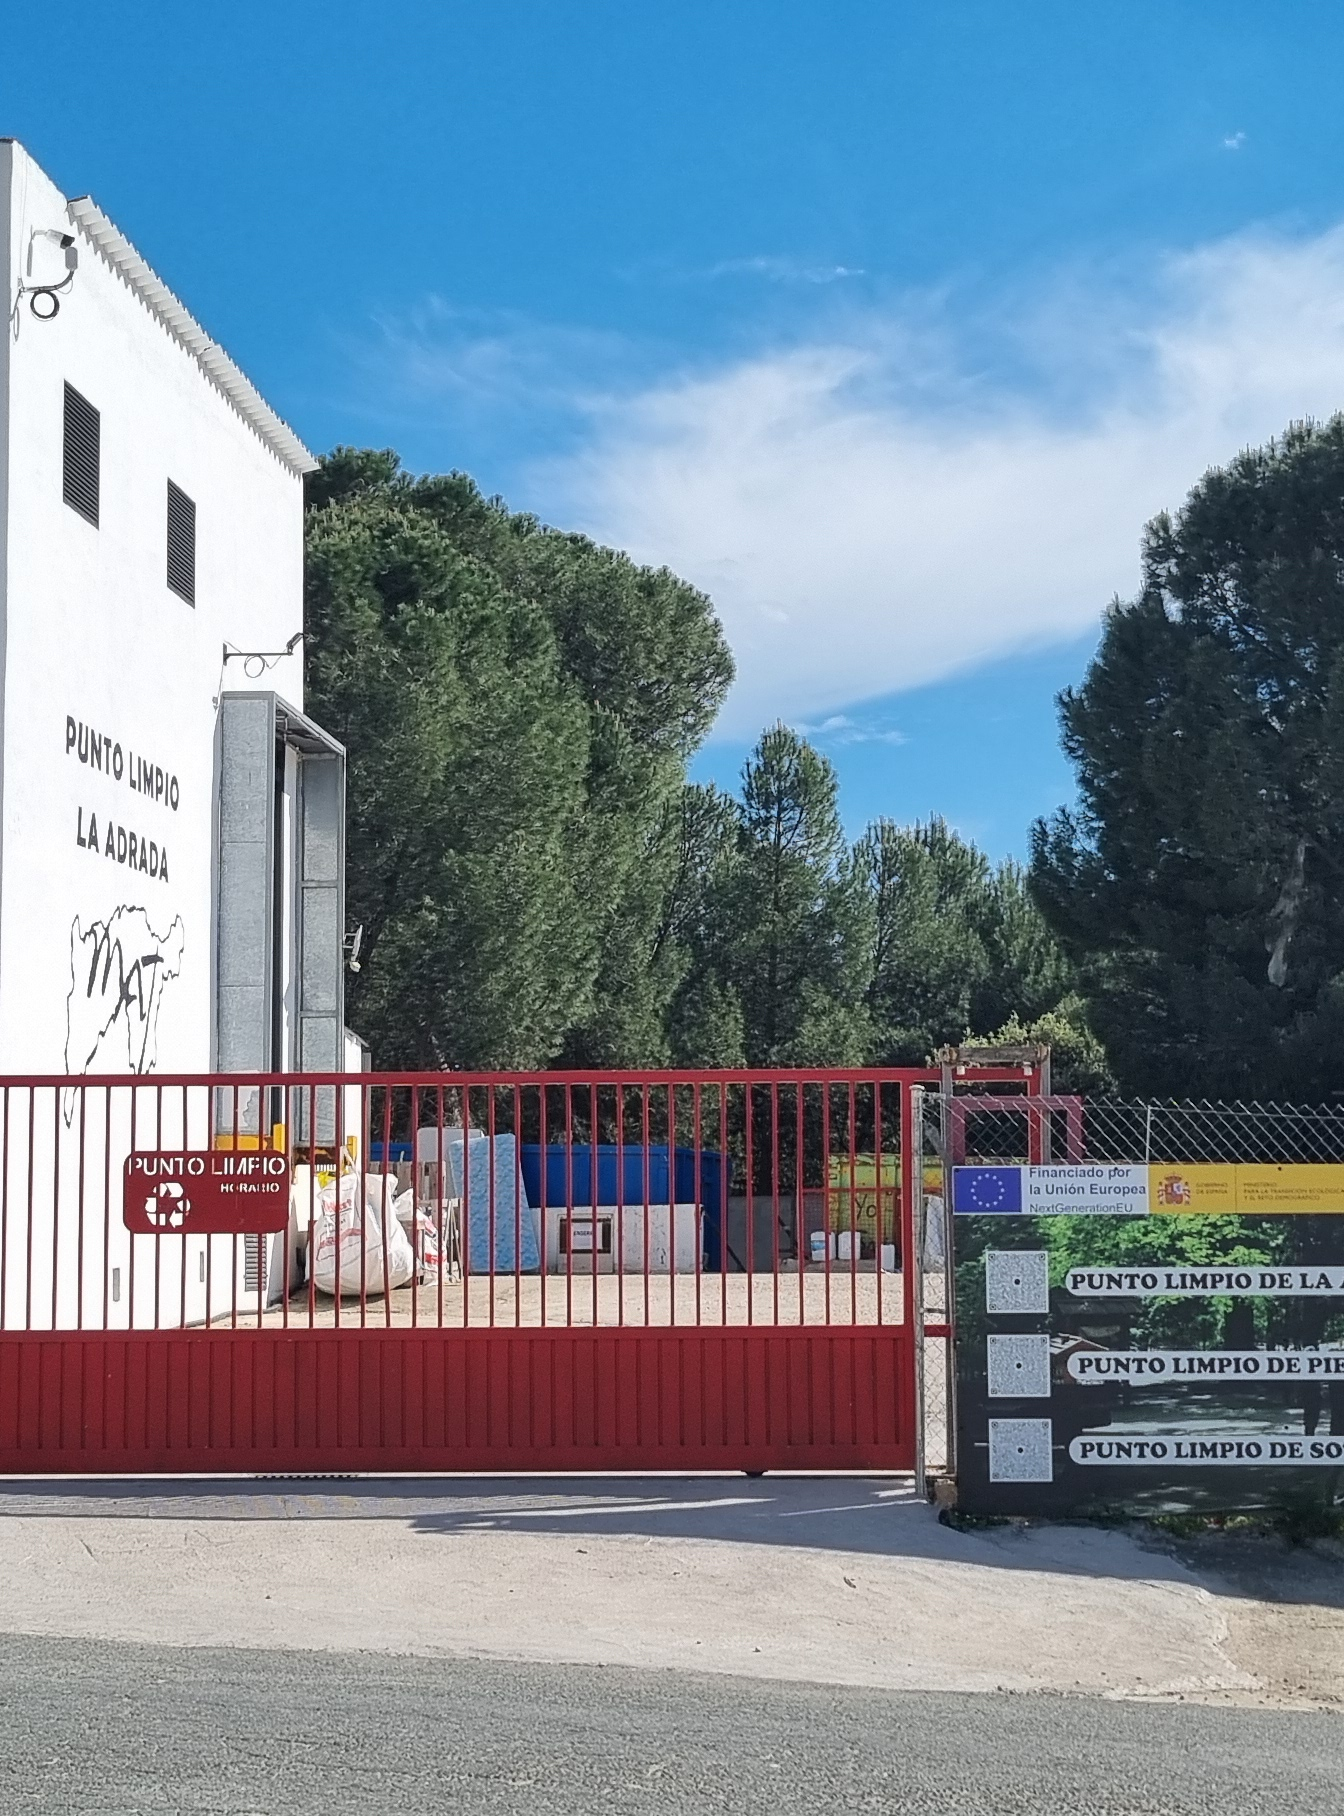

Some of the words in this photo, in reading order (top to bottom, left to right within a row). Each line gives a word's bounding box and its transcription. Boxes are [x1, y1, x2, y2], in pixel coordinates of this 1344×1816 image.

[65, 714, 124, 781] PUNTO
[129, 750, 180, 812] LIMPIO
[76, 805, 100, 854] LA
[104, 819, 169, 883] ADRADA
[128, 1156, 206, 1177] PUNTO
[1028, 1166, 1105, 1179] Financiado
[1107, 1168, 1132, 1181] por
[1028, 1183, 1042, 1195] la
[1045, 1182, 1086, 1195] Unión
[1089, 1183, 1147, 1197] Europea
[1028, 1202, 1134, 1214] NextGenerationEU
[1070, 1272, 1157, 1290] PUNTO
[1164, 1272, 1252, 1290] LIMPIO
[1259, 1272, 1294, 1290] DE
[1299, 1272, 1333, 1290] LA
[1078, 1357, 1166, 1375] PUNTO
[1172, 1357, 1260, 1375] LIMPIO
[1266, 1357, 1302, 1375] DE
[1080, 1441, 1168, 1460] PUNTO
[1174, 1441, 1264, 1460] LIMPIO
[1269, 1441, 1304, 1460] DE
